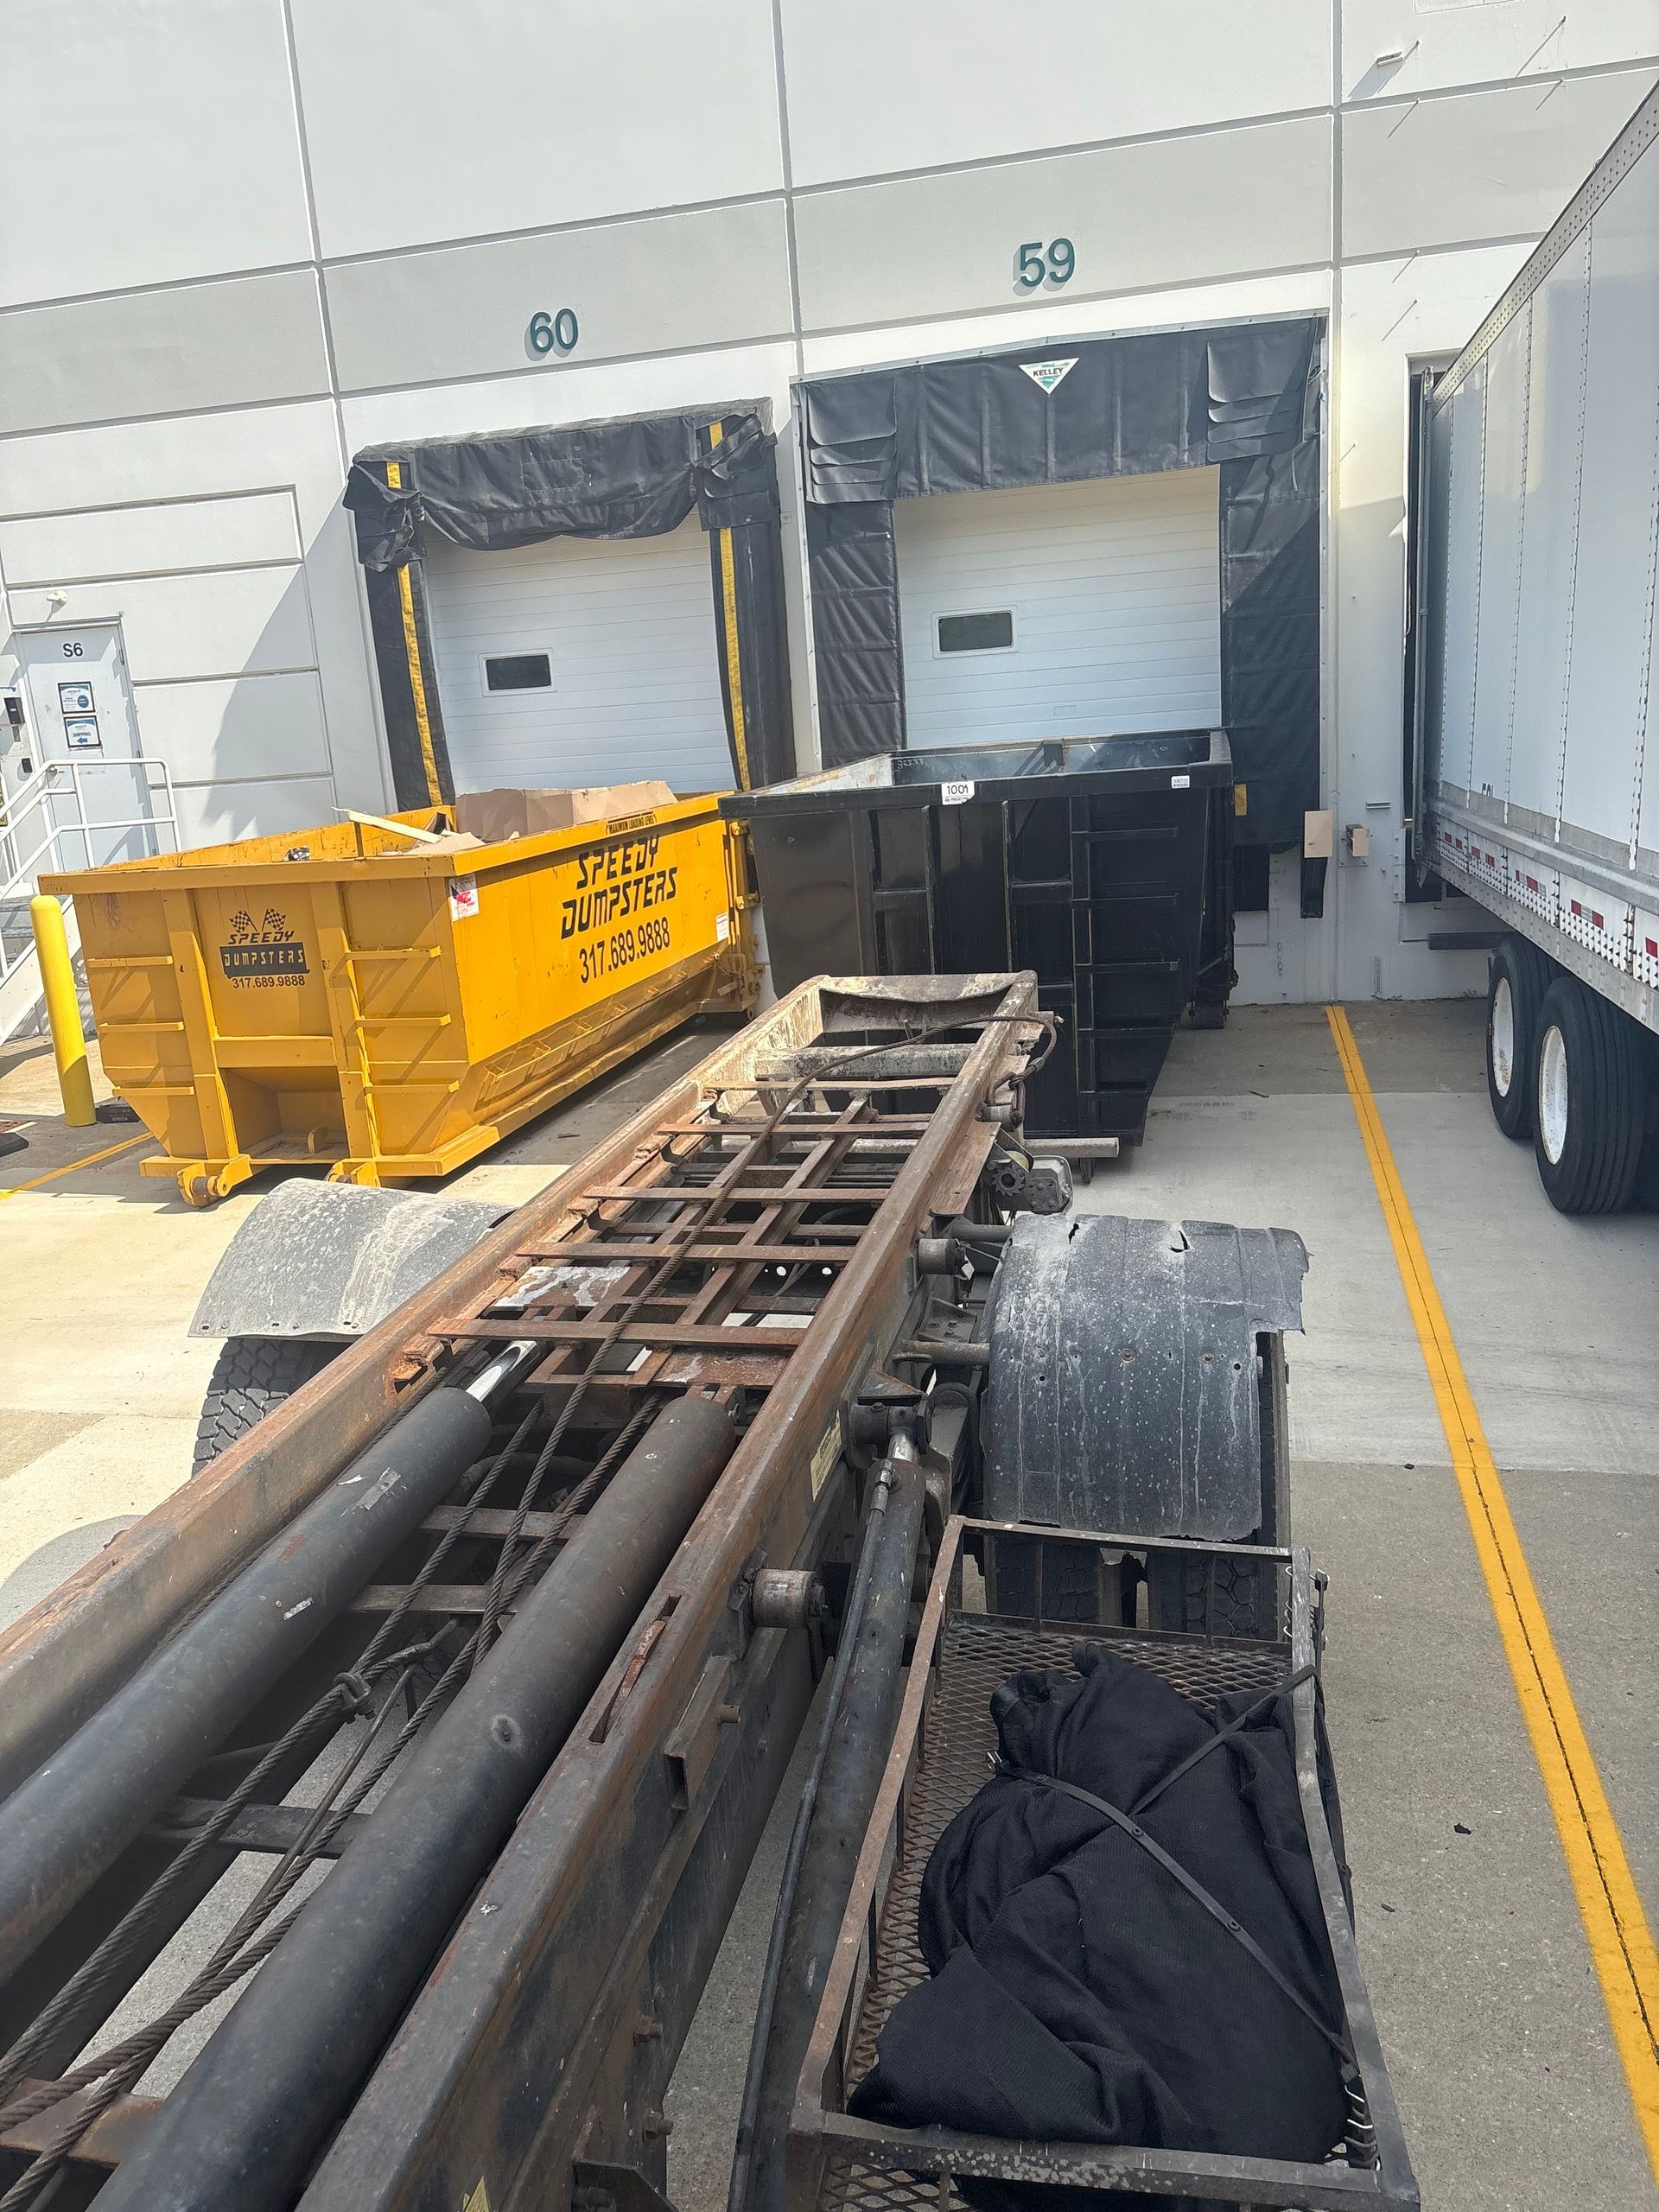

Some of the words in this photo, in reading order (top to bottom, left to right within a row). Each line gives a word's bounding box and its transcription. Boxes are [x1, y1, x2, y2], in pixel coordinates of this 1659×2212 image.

[1020, 238, 1075, 287] 59
[531, 308, 578, 353] 60
[1033, 367, 1064, 377] KELLEY
[62, 642, 84, 658] S6
[576, 834, 660, 890] SPEEDY
[561, 867, 677, 940] DUMPSTERS
[228, 931, 295, 944] SPEEDY
[579, 916, 671, 984] 317.689.9888
[225, 950, 304, 967] DUMPSTERS
[232, 975, 305, 988] 317.689.9888
